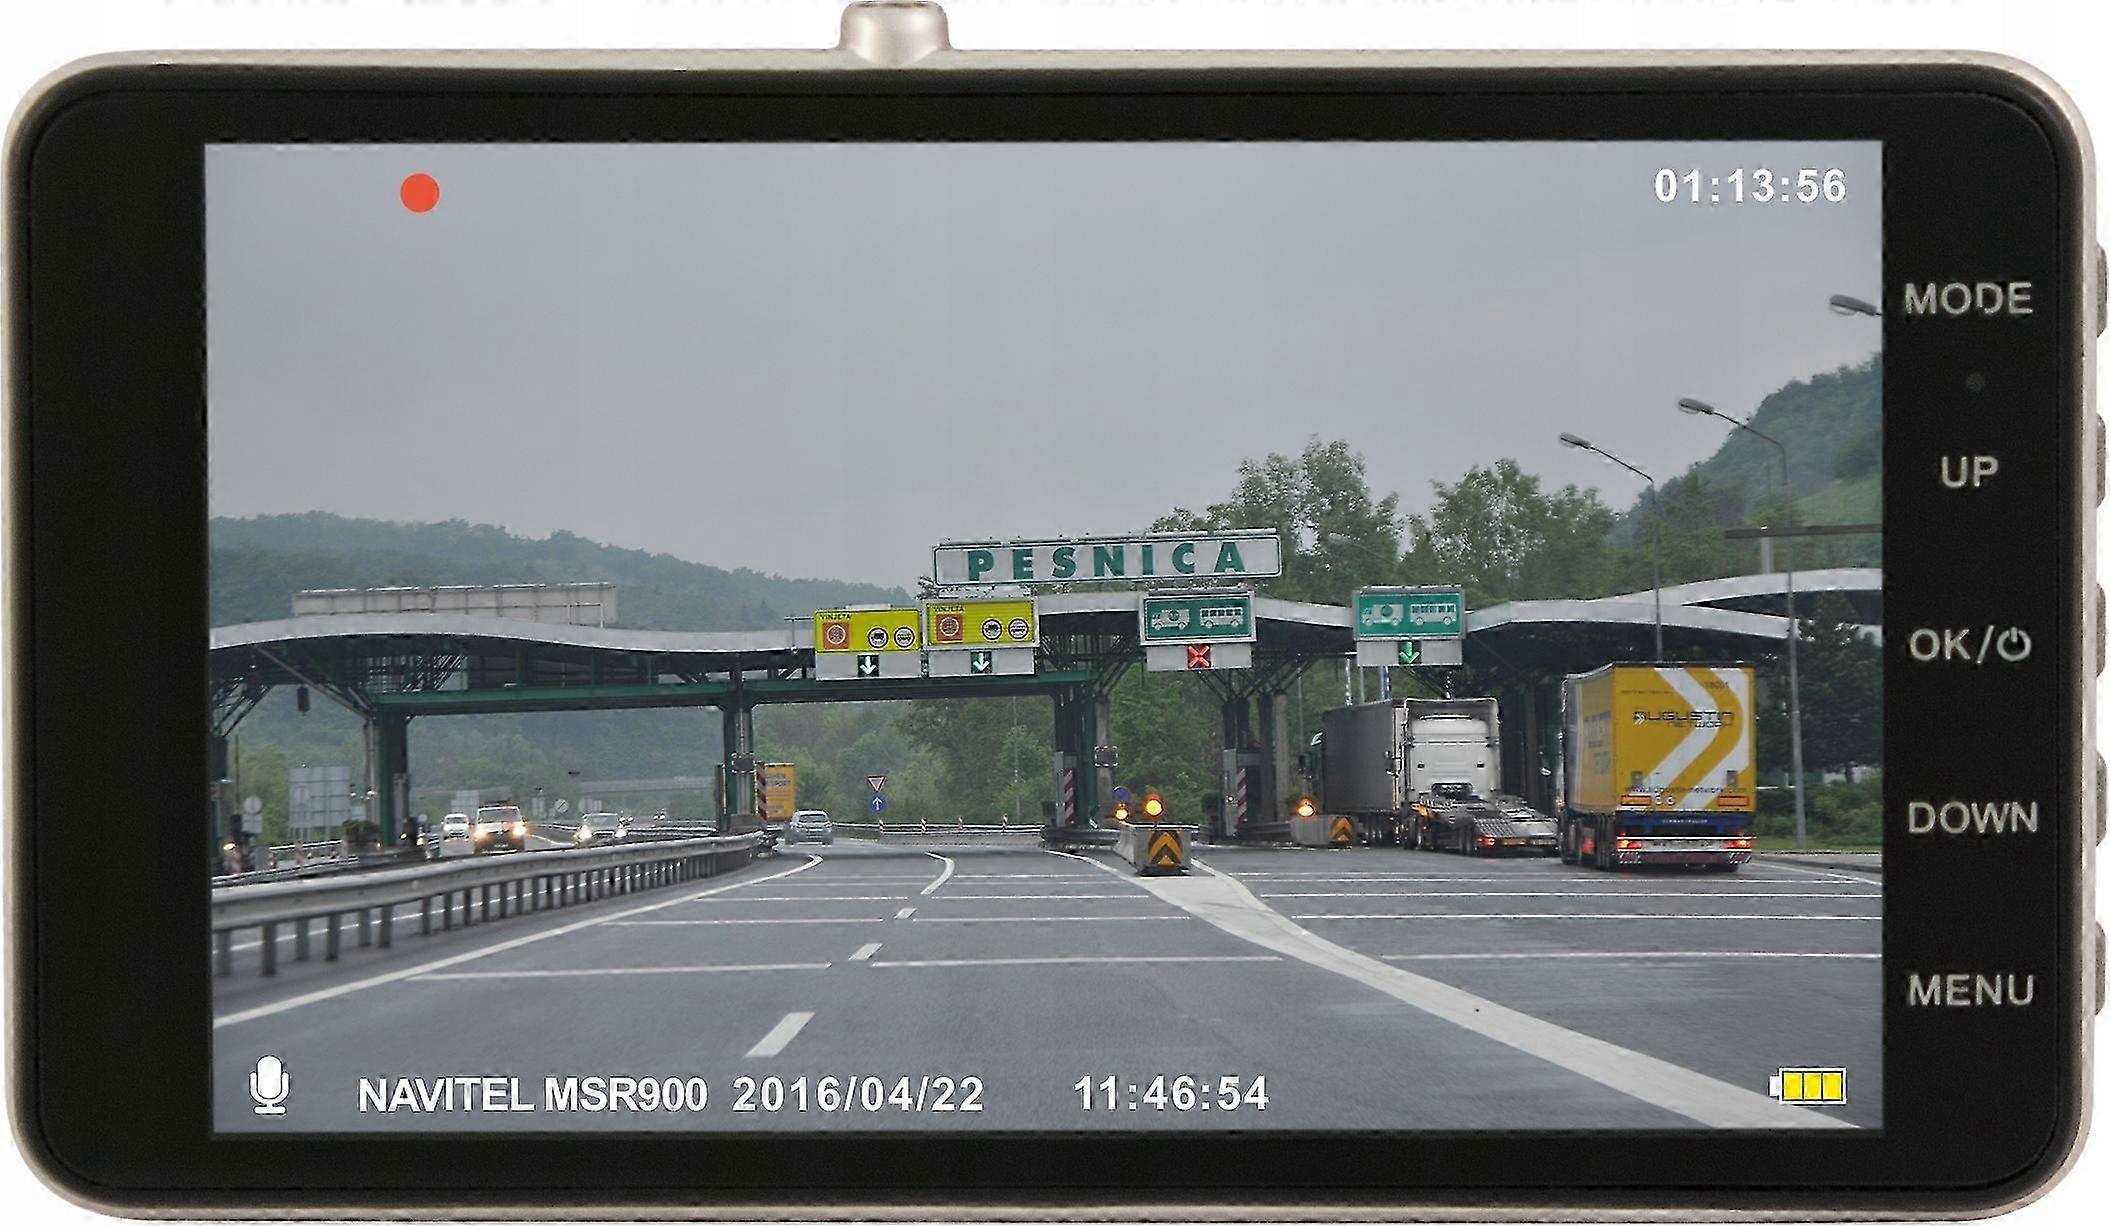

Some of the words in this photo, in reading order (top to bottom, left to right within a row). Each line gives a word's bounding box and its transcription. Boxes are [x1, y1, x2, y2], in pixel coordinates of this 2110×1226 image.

[1655, 167, 1847, 205] 01:13:56
[1904, 281, 2034, 315] MODE
[1941, 455, 1999, 488] UP
[967, 541, 1247, 582] PESNICA
[1908, 801, 2038, 834] DOWN
[1909, 973, 2035, 1007] MENU
[358, 1075, 535, 1111] NAVITEL
[545, 1075, 708, 1111] MSR900
[732, 1074, 984, 1112] 2016/04/22
[1074, 1074, 1270, 1111] 11:46:54
